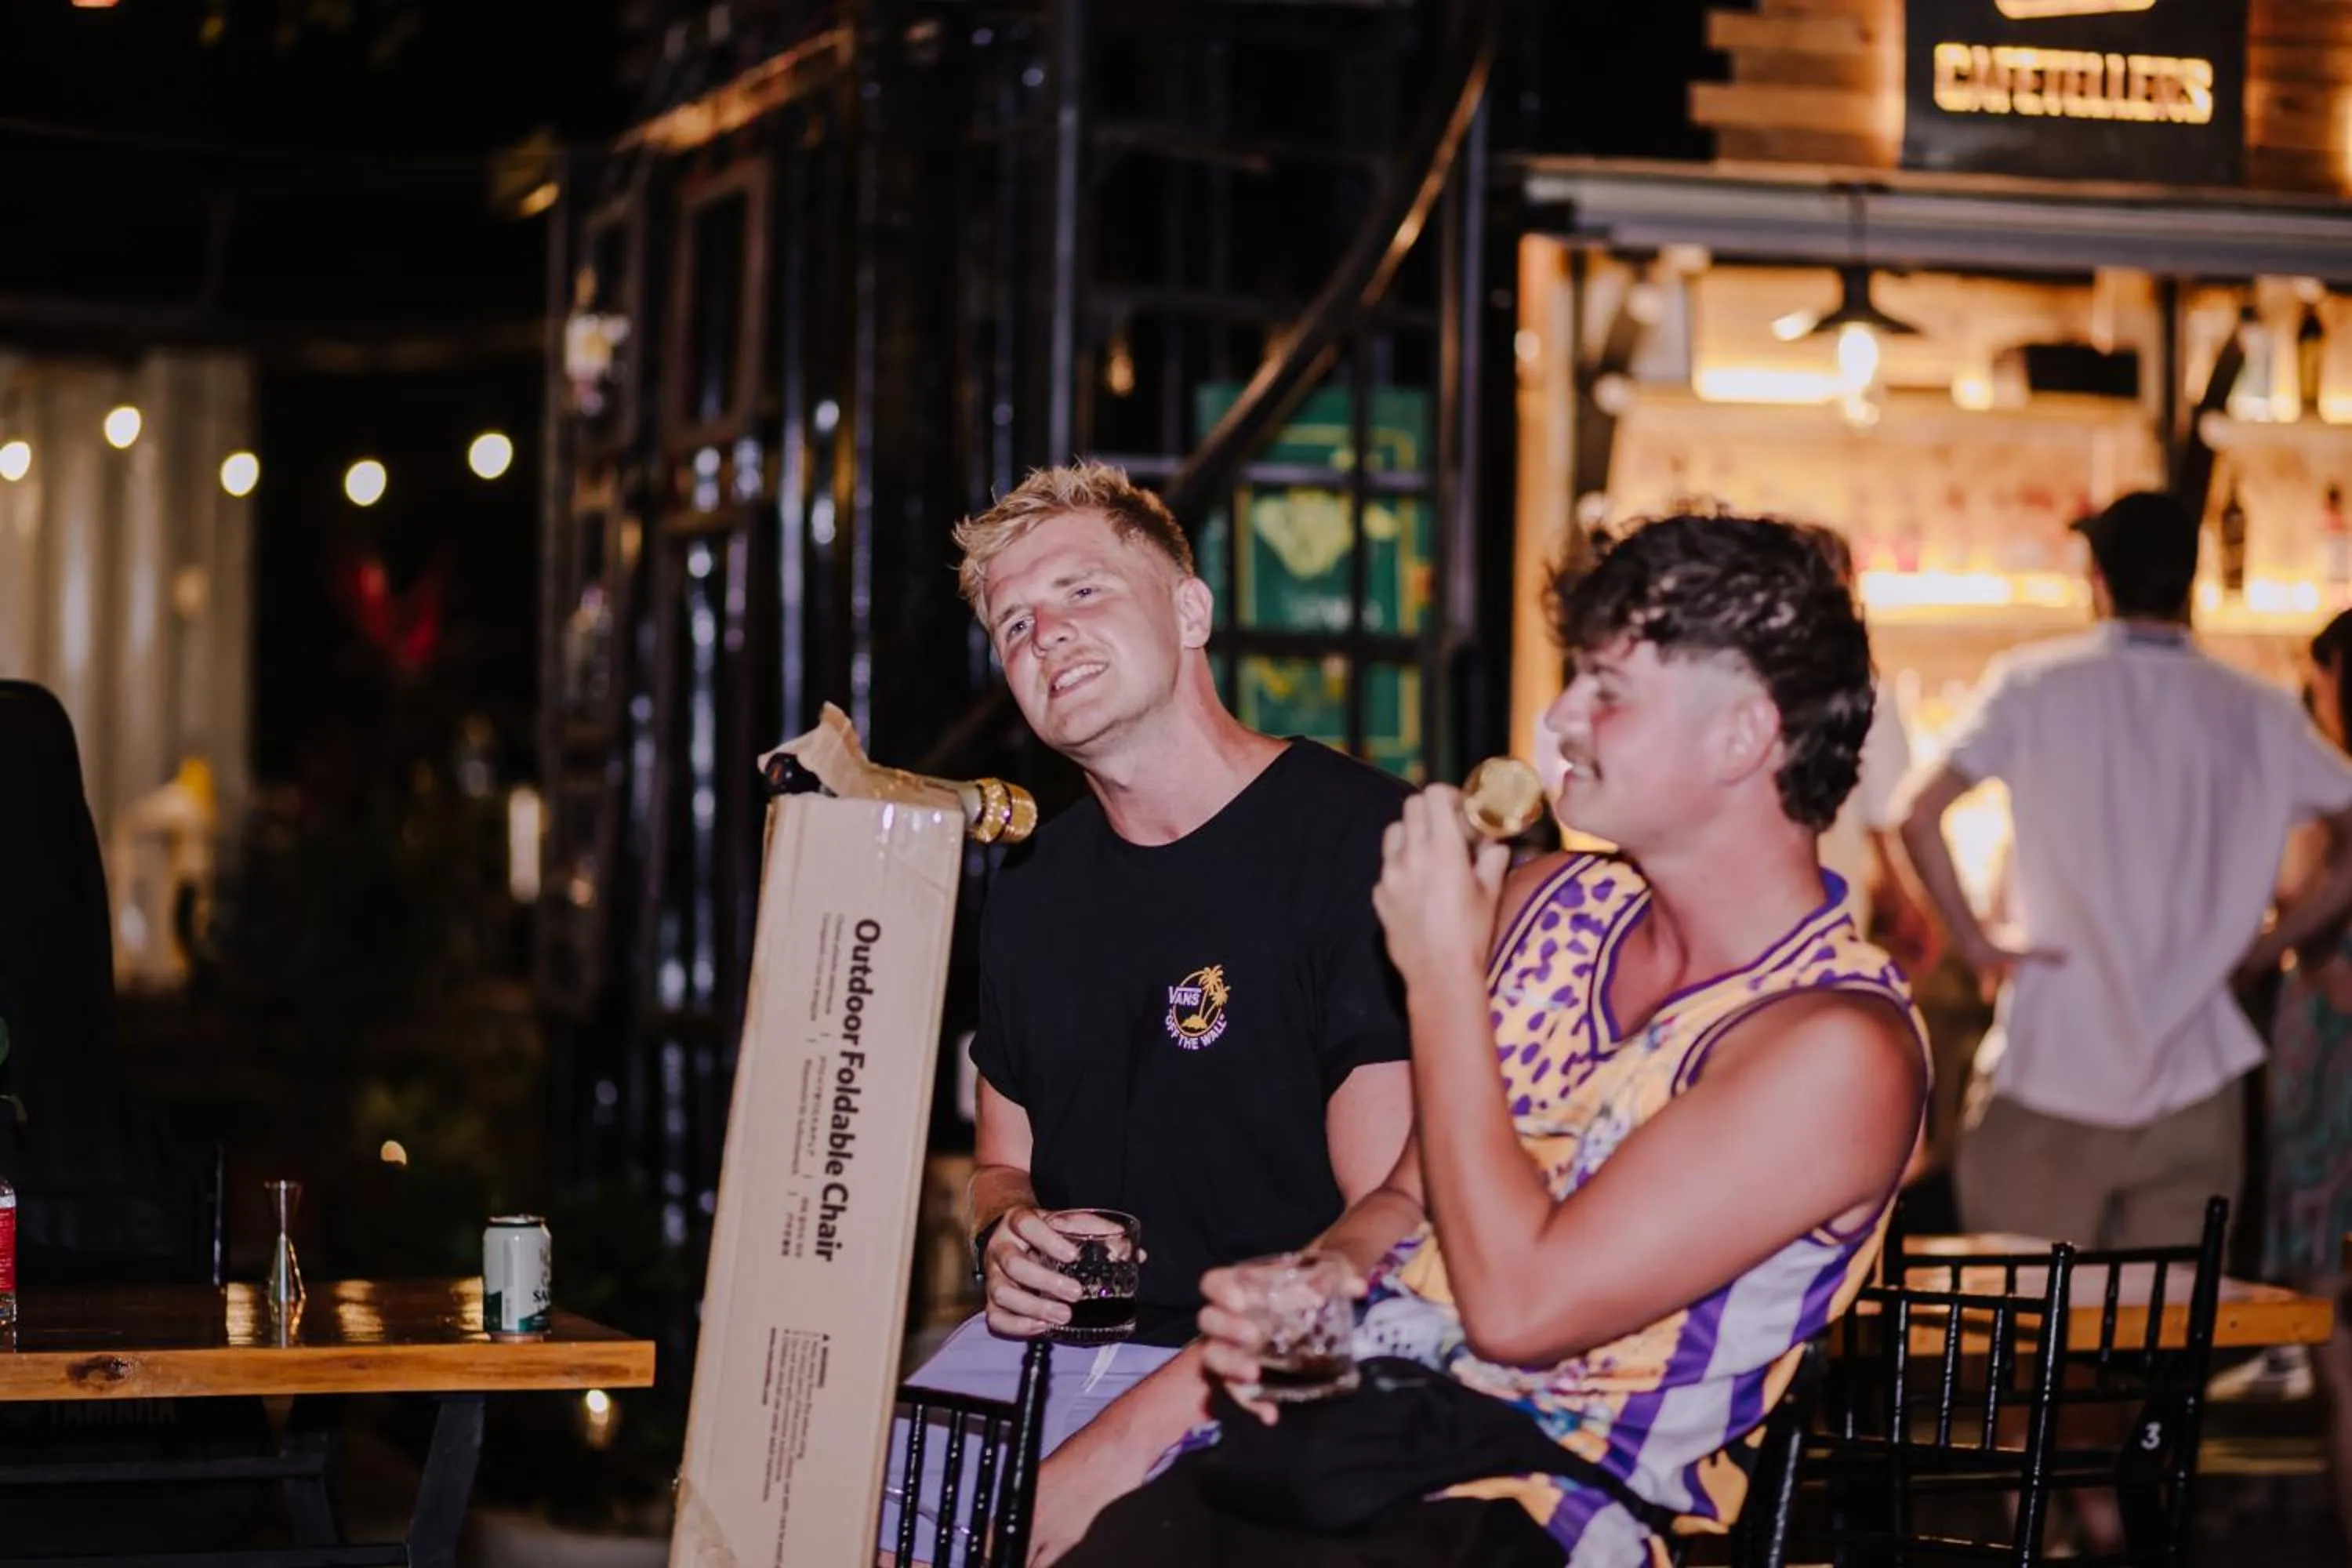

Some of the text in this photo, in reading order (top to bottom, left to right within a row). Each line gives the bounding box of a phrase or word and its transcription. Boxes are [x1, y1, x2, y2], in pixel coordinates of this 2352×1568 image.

[841, 919, 881, 1047] Outdoor
[1168, 985, 1202, 1006] VANS
[1178, 1033, 1199, 1050] THE
[824, 1051, 866, 1177] Foldable
[815, 1181, 849, 1262] Chair
[2140, 1421, 2161, 1450] 3
